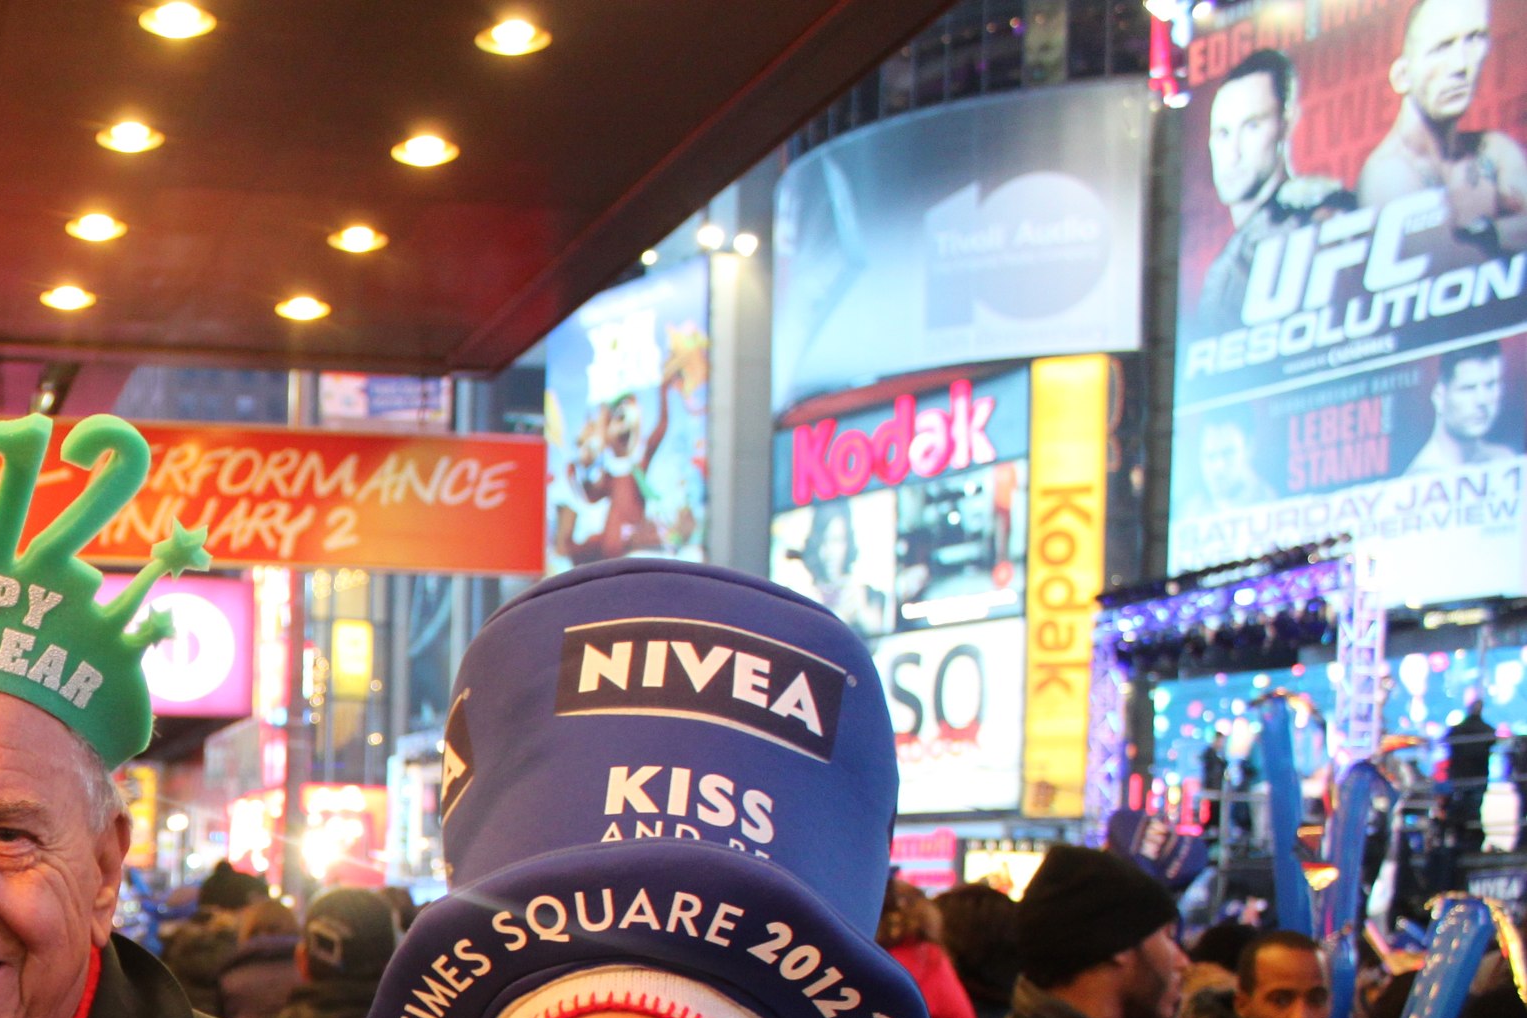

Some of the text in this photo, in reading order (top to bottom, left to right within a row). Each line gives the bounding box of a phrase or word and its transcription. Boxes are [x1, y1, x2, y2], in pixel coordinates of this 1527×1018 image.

[1184, 250, 1526, 382] RESOLUTION
[1243, 188, 1447, 328] UFC
[792, 378, 997, 506] Kodak
[323, 507, 361, 551] 2
[1036, 482, 1094, 694] Kodak
[578, 639, 825, 738] NIVEA
[603, 765, 775, 845] KISS
[490, 886, 746, 953] SQUARE
[746, 920, 863, 1018] 2012
